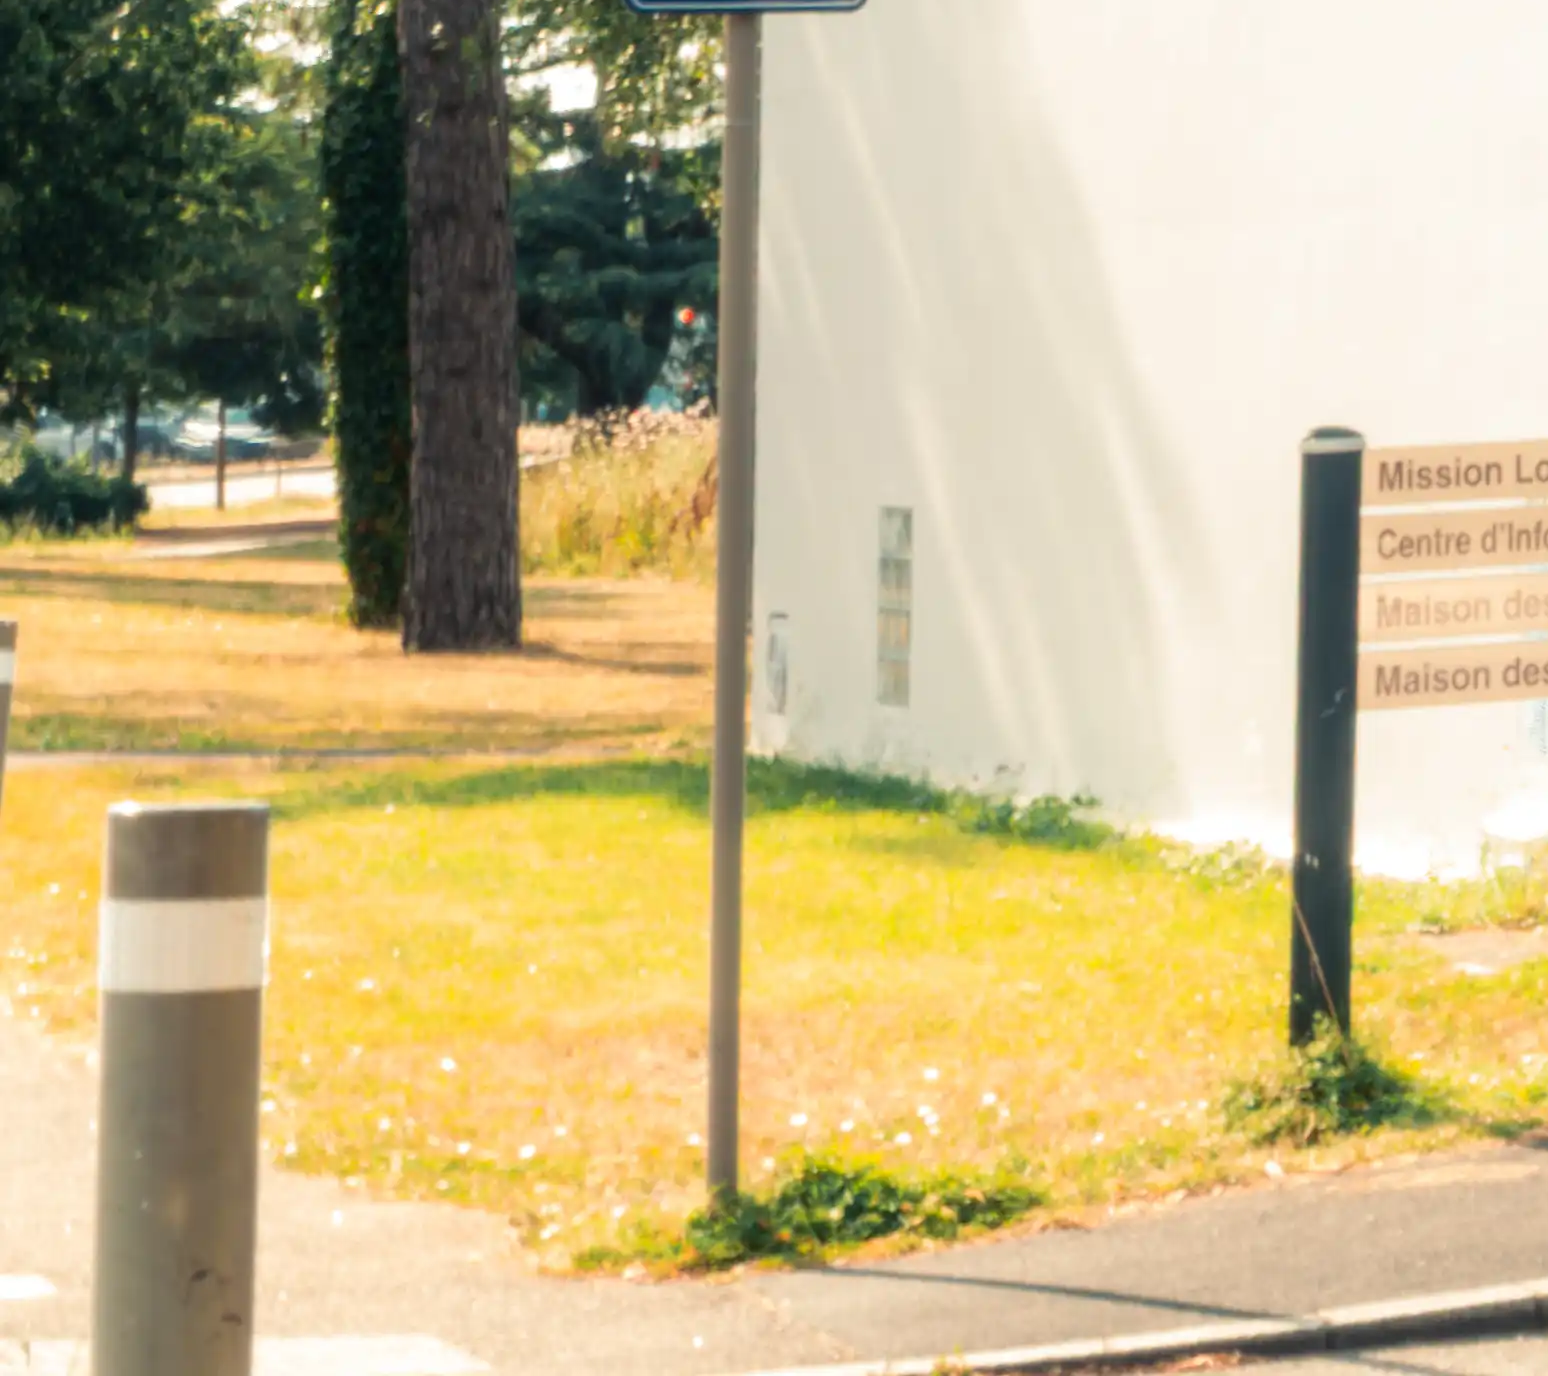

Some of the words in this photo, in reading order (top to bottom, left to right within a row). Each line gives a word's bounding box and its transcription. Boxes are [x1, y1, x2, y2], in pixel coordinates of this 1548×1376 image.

[1377, 458, 1503, 492] Mission
[1377, 527, 1472, 560] Centre
[1375, 593, 1492, 629] Maison
[1374, 662, 1491, 697] Maison
